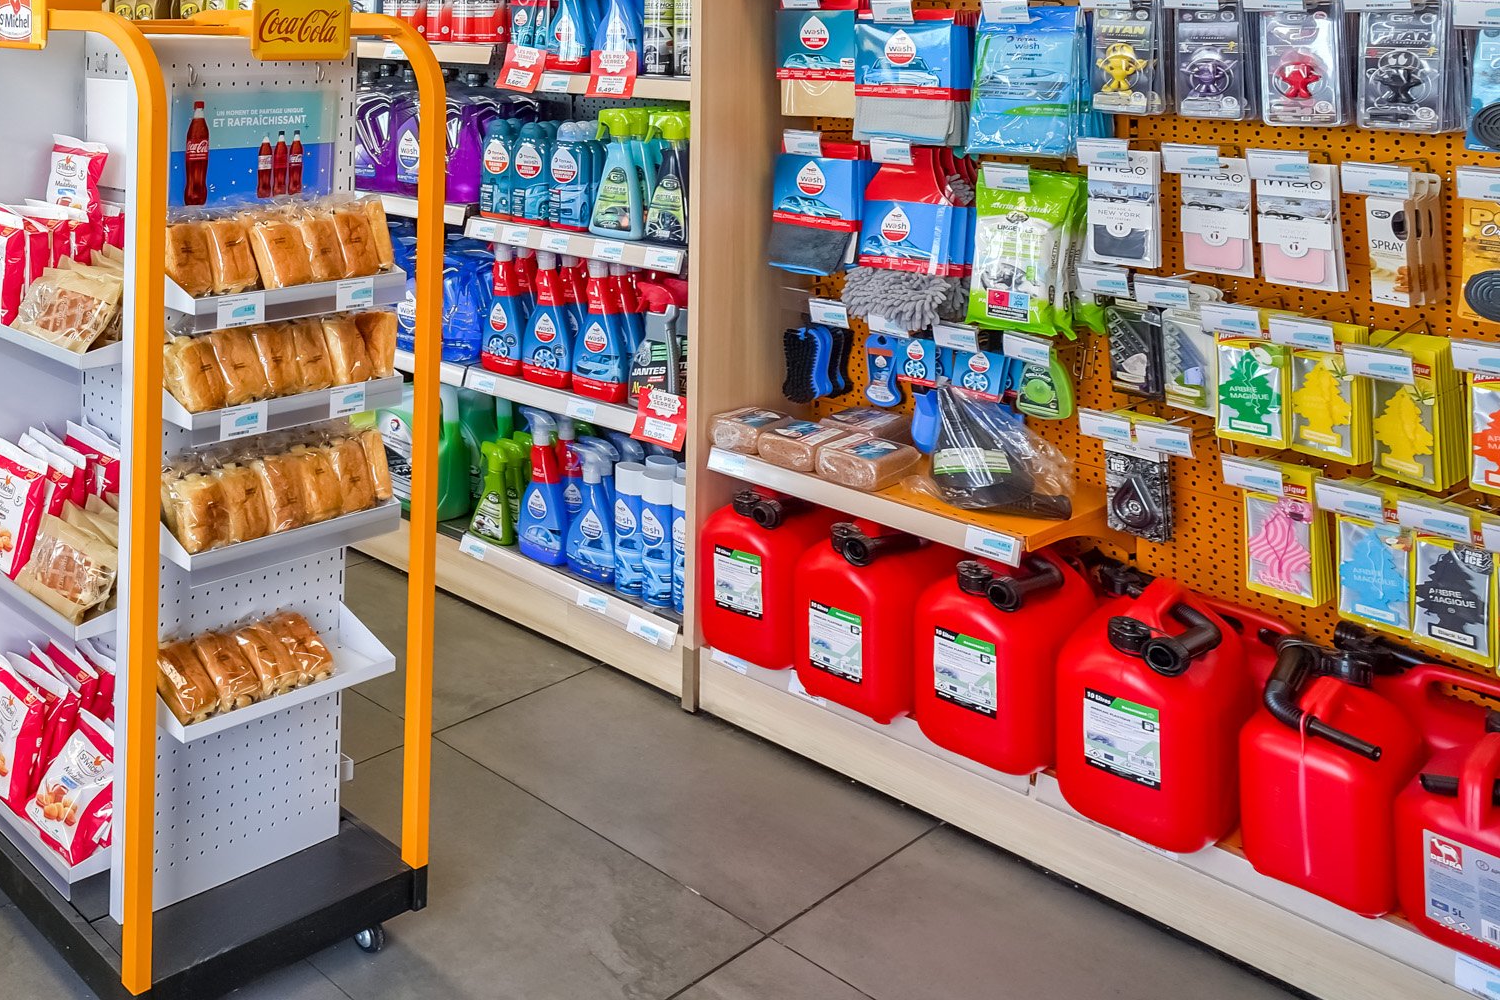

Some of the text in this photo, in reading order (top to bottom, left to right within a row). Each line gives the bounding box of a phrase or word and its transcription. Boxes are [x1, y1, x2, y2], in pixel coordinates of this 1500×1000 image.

[258, 7, 340, 46] Coca-Cola
[1100, 25, 1145, 35] TITAN
[803, 27, 826, 37] wash
[888, 43, 912, 53] wash
[259, 107, 283, 115] PARTAGE
[284, 106, 304, 114] UNIQUE
[212, 113, 307, 128] ET RAFRAÎCHISSANT
[400, 146, 418, 155] wash
[1097, 209, 1116, 217] NEW
[885, 220, 908, 231] wash
[1371, 239, 1404, 252] SPRAY
[538, 325, 554, 333] wash
[587, 334, 605, 343] wash
[632, 366, 667, 377] JANTES
[1229, 385, 1257, 393] ARBRE
[651, 393, 677, 405] LES PRIX
[1230, 392, 1269, 401] MAGIQUE
[530, 500, 545, 509] wash
[1464, 557, 1483, 567] ICE
[1429, 587, 1463, 599] ARBRE
[1086, 691, 1111, 705] 10 Litres
[1430, 853, 1463, 871] DEURA
